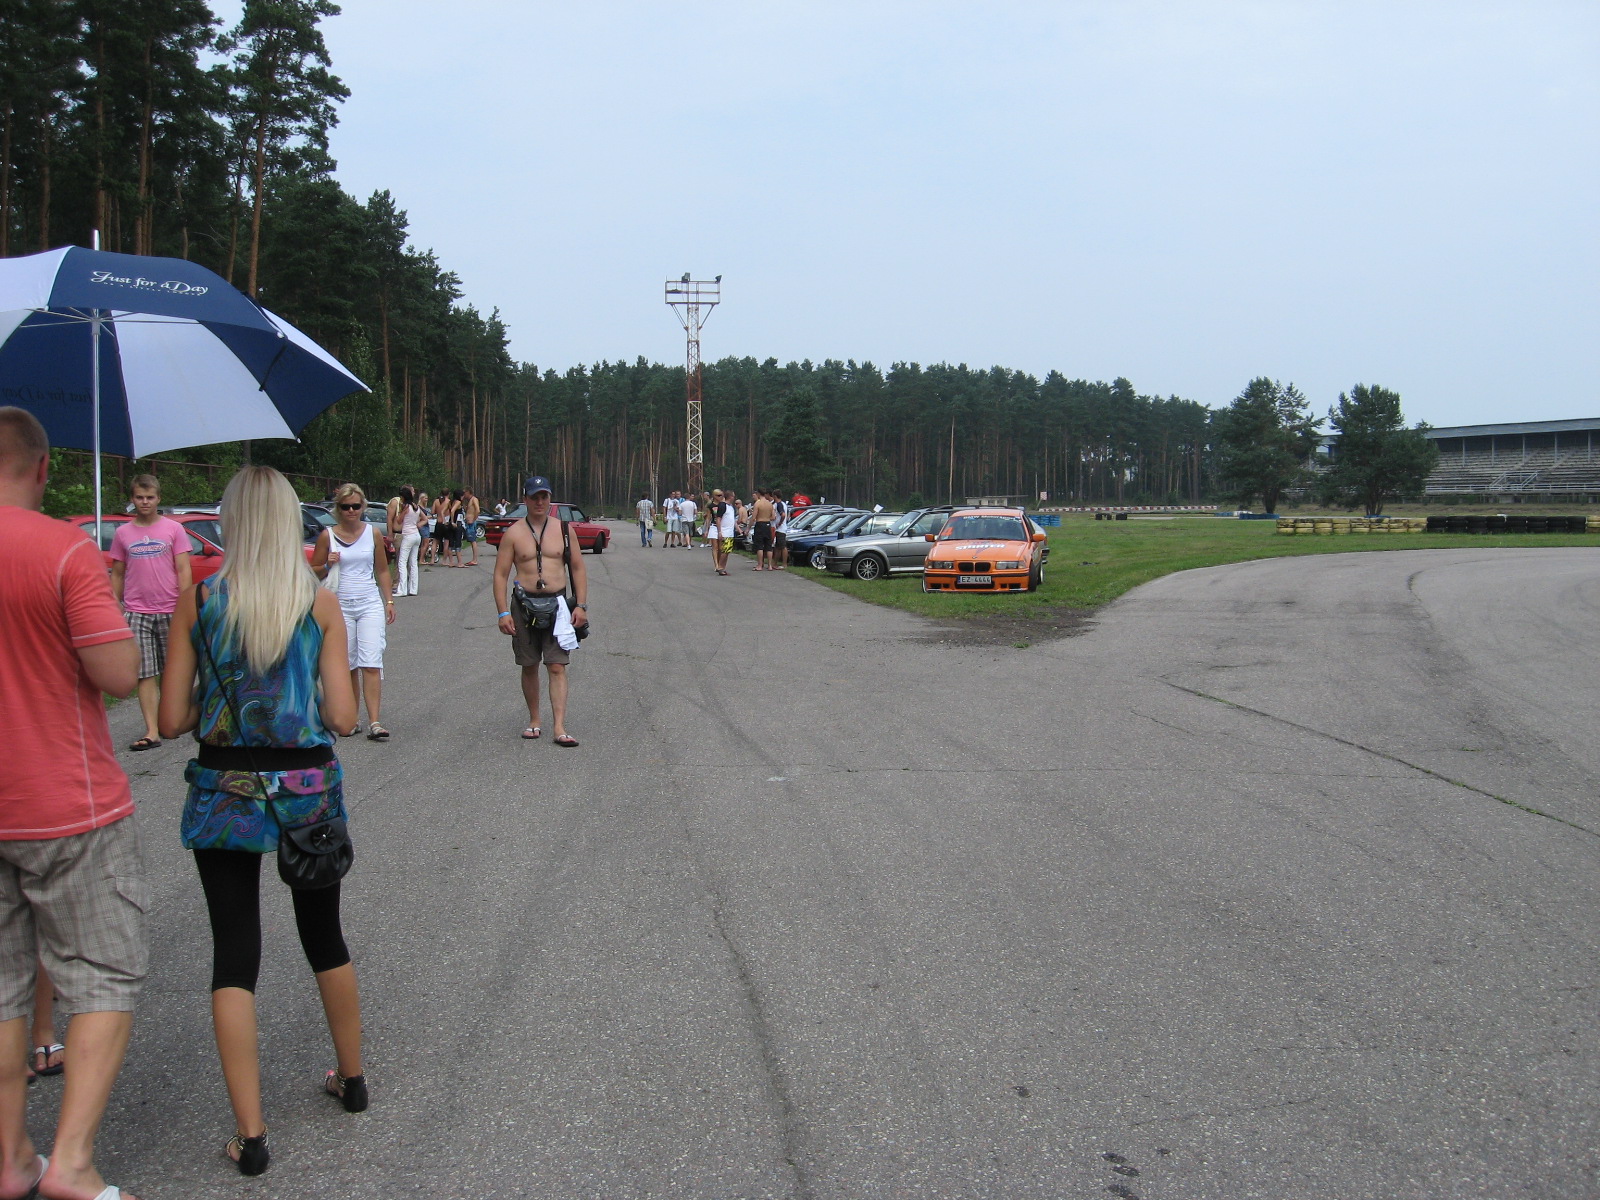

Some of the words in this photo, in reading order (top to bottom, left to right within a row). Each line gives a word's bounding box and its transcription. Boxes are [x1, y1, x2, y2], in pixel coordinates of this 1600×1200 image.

[90, 271, 133, 284] Just
[135, 277, 158, 287] for
[160, 281, 170, 289] a
[167, 280, 209, 295] Day
